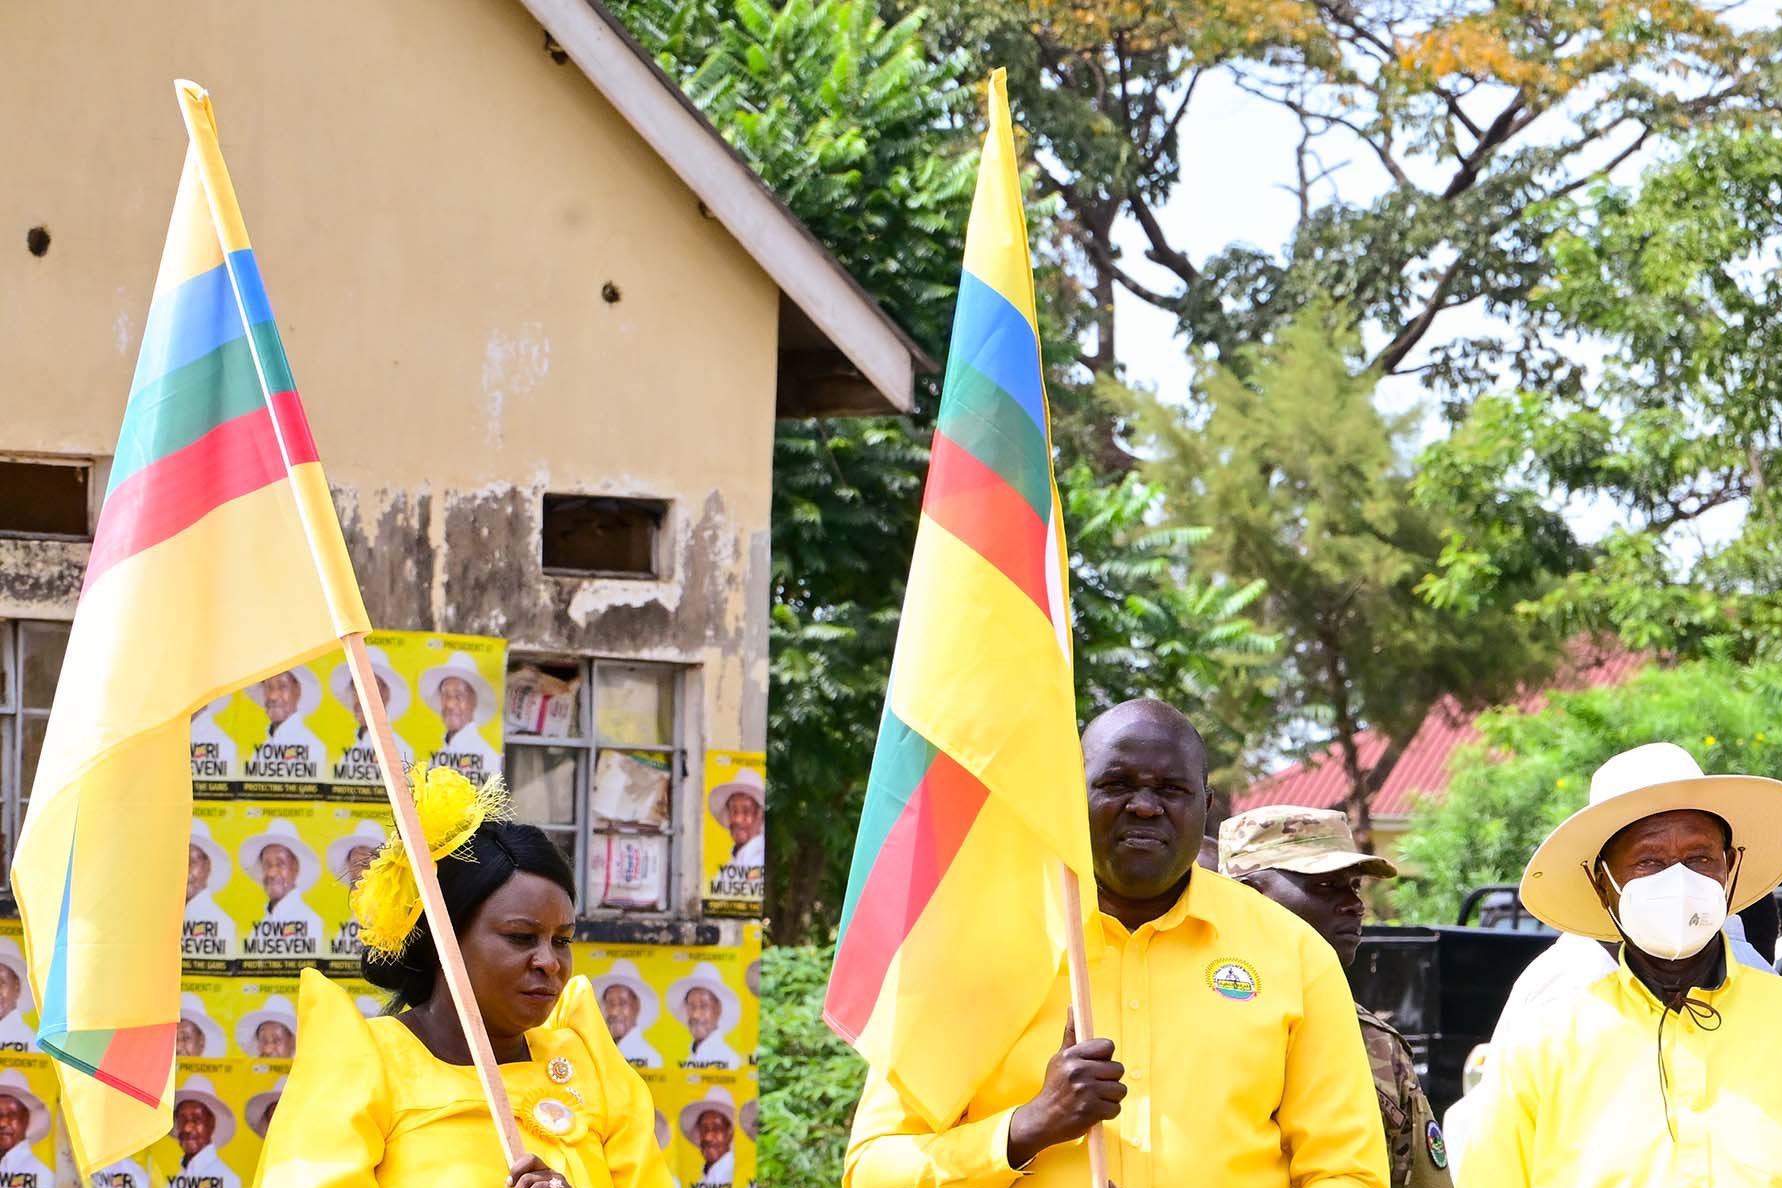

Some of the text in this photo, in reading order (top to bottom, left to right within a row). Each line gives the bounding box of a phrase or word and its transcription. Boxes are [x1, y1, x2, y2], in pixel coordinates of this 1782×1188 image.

[254, 743, 310, 761] YOWERI
[343, 747, 379, 764] YOW
[430, 752, 484, 769] YOWERI
[245, 760, 318, 778] MUSEVENI
[334, 763, 381, 780] MUSEV
[183, 921, 218, 937] WERI
[253, 921, 309, 938] YOWERI
[182, 938, 226, 955] EVENI
[244, 938, 317, 955] MUSEVENI
[0, 1172, 37, 1188] WERI
